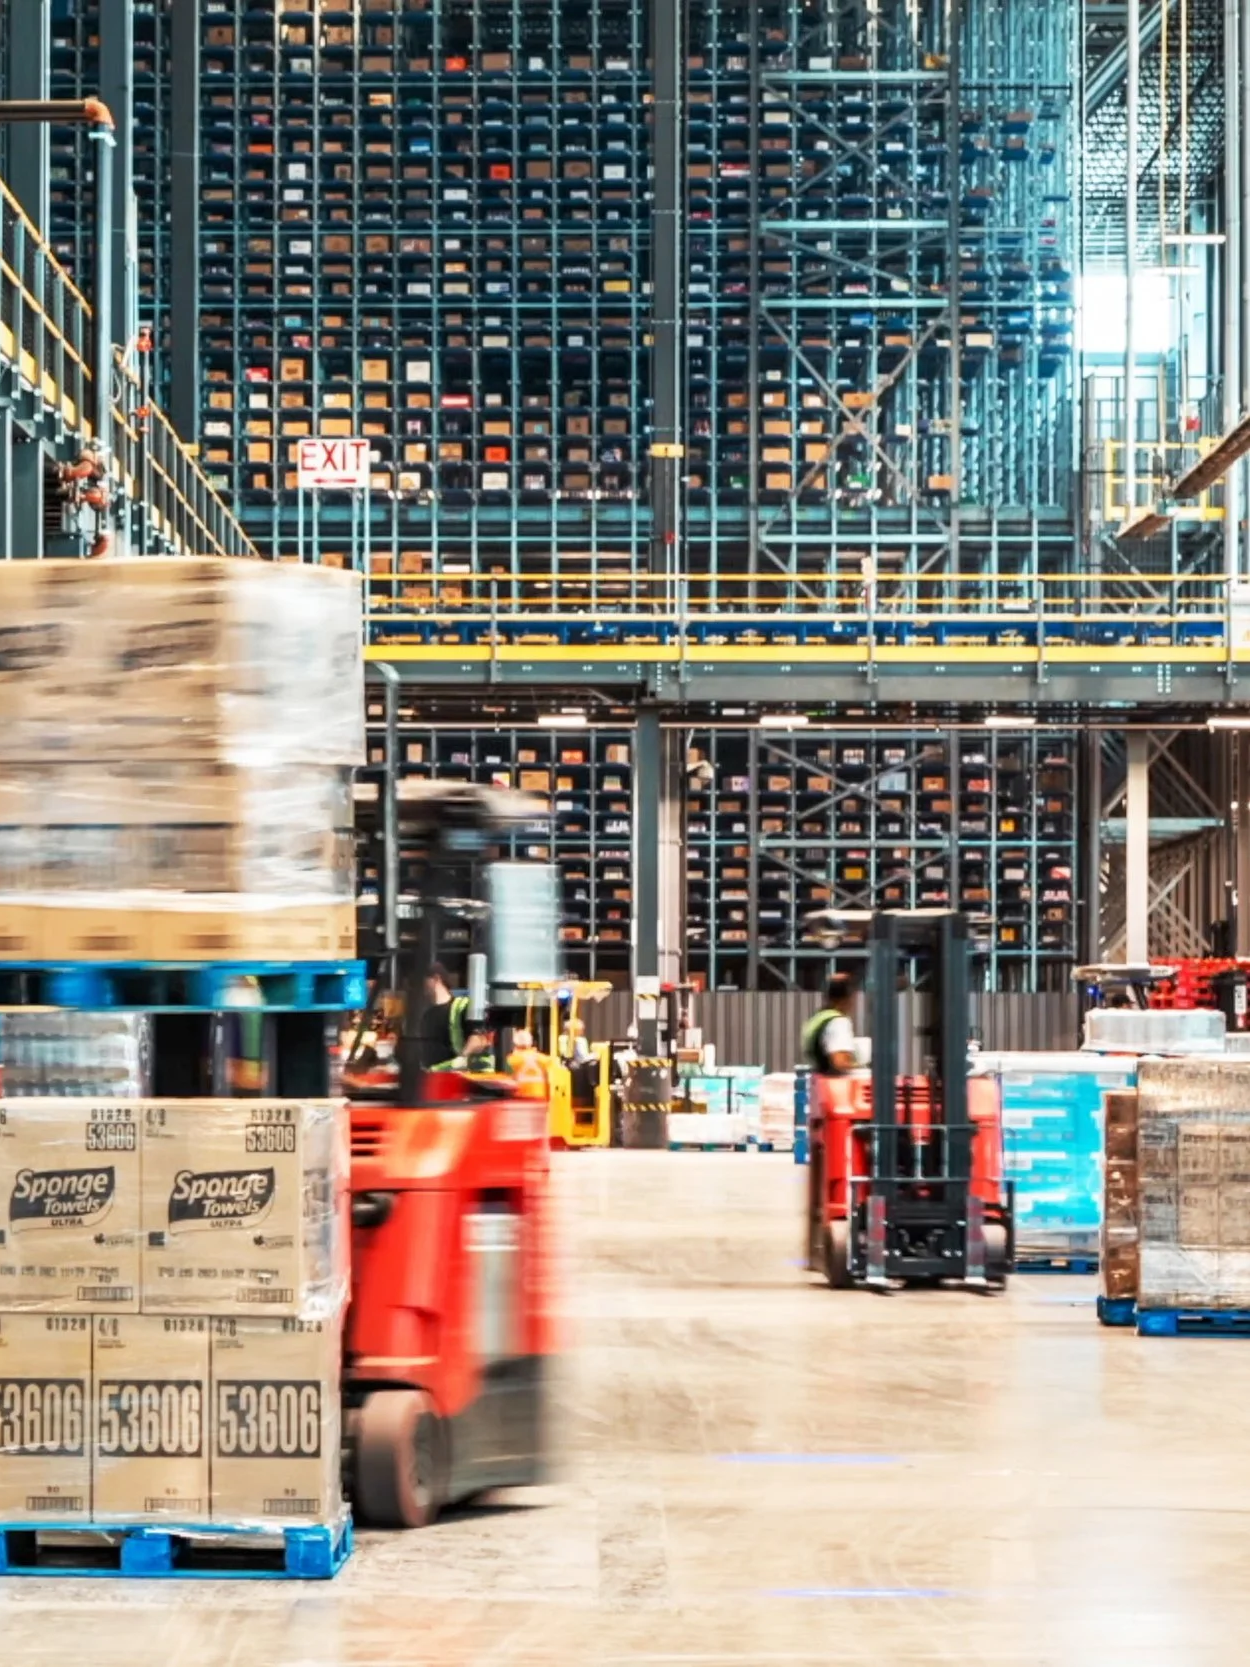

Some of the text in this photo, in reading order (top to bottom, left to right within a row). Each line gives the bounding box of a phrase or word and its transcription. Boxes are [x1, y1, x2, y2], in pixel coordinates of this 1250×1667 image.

[301, 443, 367, 470] EXIT
[88, 1123, 134, 1150] 53606
[247, 1125, 295, 1151] 53606
[14, 1169, 108, 1203] Sponge
[173, 1170, 268, 1205] Sponge
[43, 1196, 101, 1215] Towels
[202, 1197, 261, 1216] Towels
[51, 1218, 84, 1226] ULTRA
[100, 1384, 201, 1455] 53606
[219, 1385, 319, 1455] 53606
